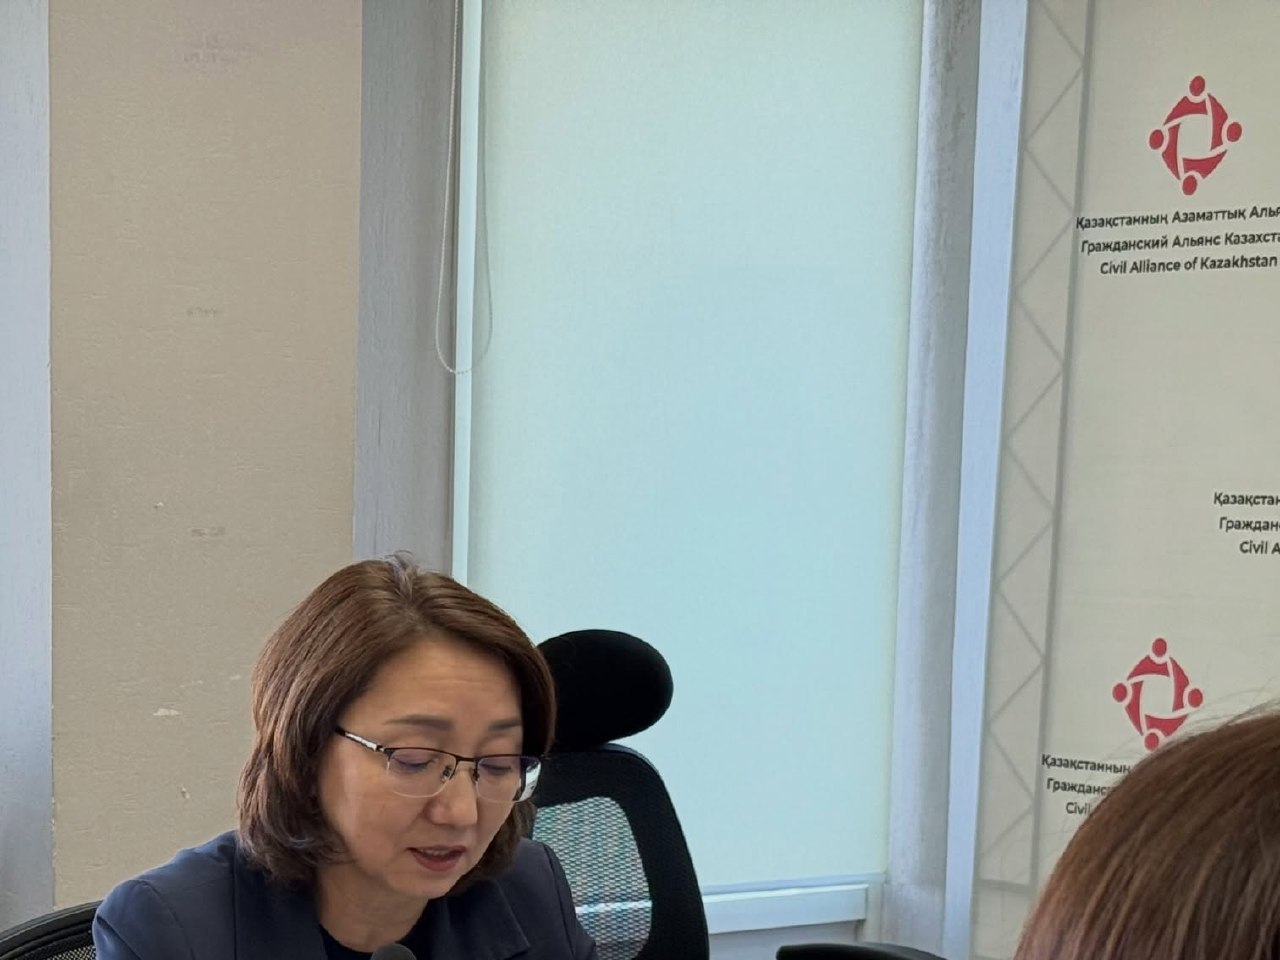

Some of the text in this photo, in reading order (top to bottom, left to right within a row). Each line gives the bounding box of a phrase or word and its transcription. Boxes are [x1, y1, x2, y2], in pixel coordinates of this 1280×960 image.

[1076, 214, 1168, 230] Қазақстанның
[1172, 208, 1247, 223] Азаматтық
[1081, 236, 1168, 255] Гражданский
[1172, 234, 1221, 249] Альянс
[1100, 255, 1277, 275] Civil Alliance of Kazakhstan
[1239, 539, 1268, 555] Civil
